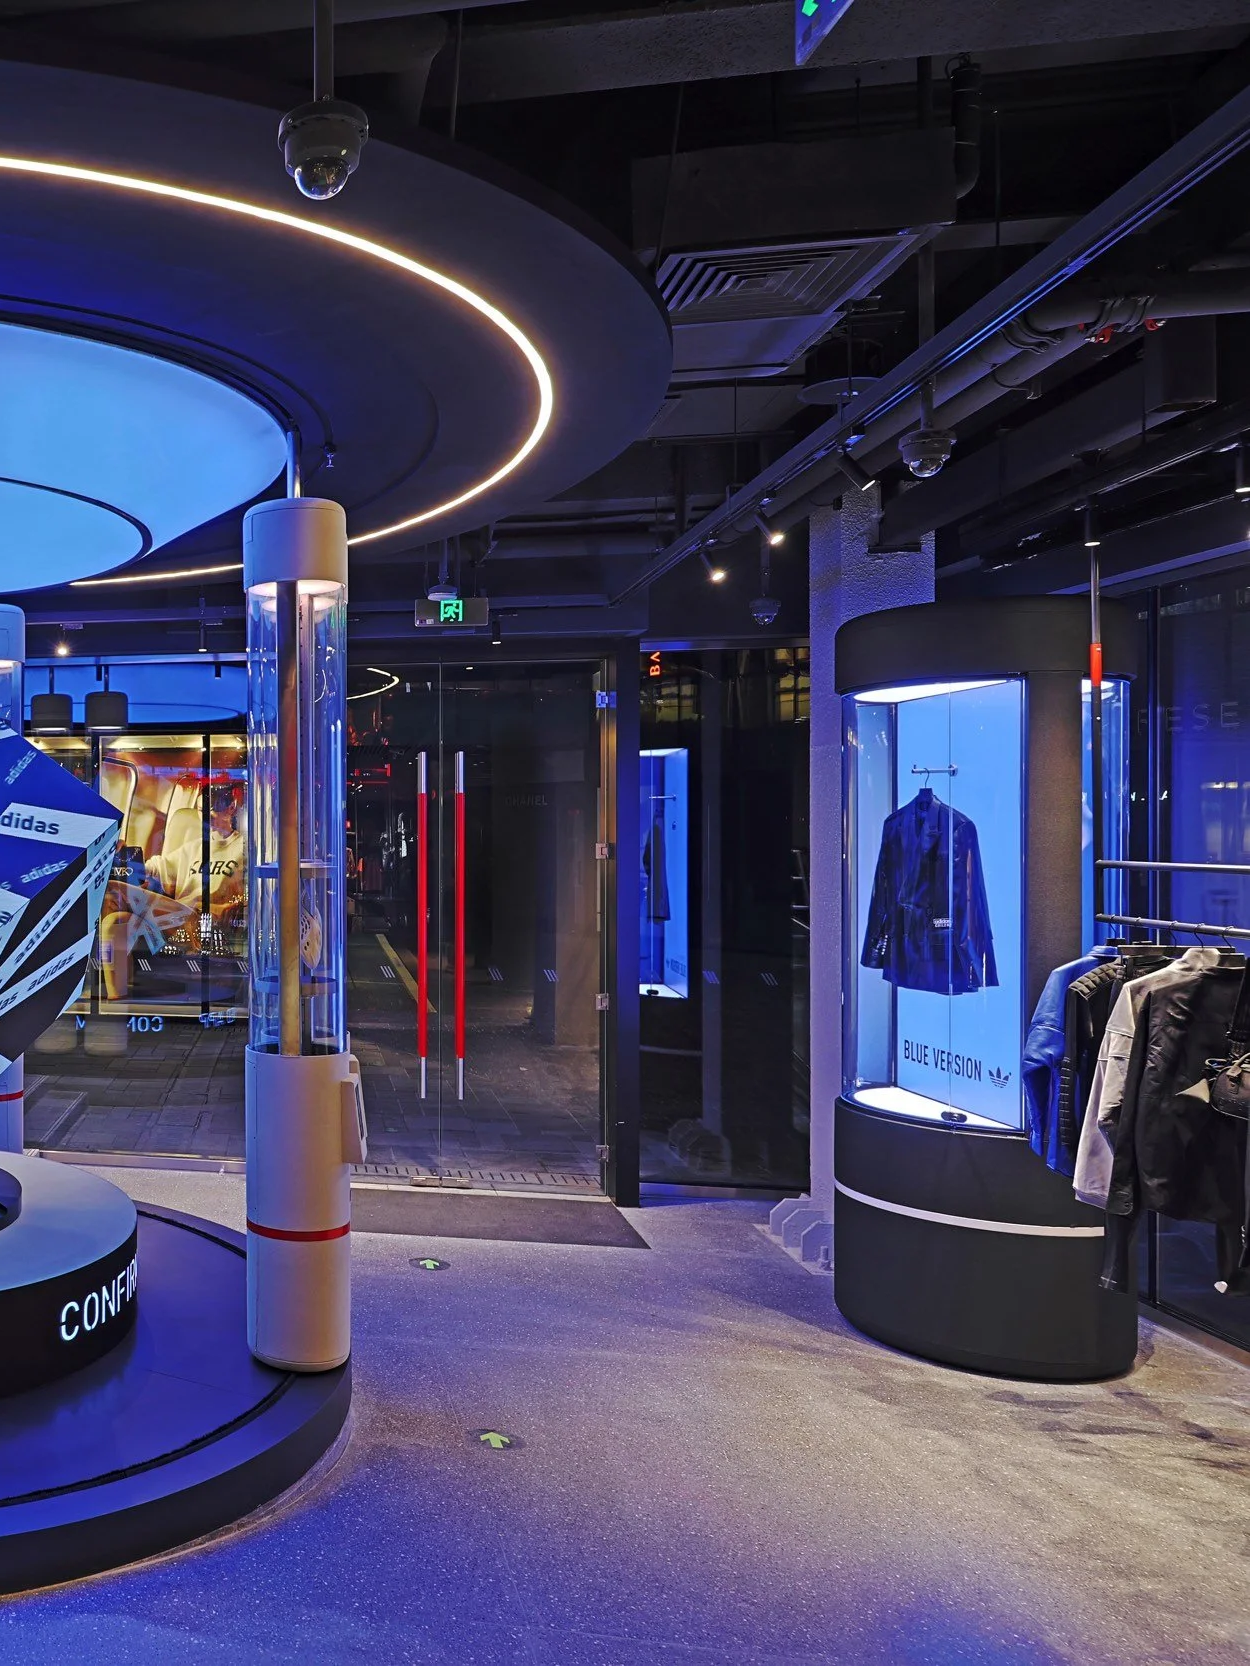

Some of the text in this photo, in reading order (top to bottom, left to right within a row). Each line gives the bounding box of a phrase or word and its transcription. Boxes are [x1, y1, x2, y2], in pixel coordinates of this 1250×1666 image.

[5, 750, 37, 785] adidas
[0, 812, 60, 836] didas
[20, 859, 69, 884] adidas
[14, 899, 70, 964] adidas
[27, 952, 75, 992] adidas
[904, 1040, 982, 1082] BLUE VERSION
[60, 1253, 138, 1341] CONFIR
